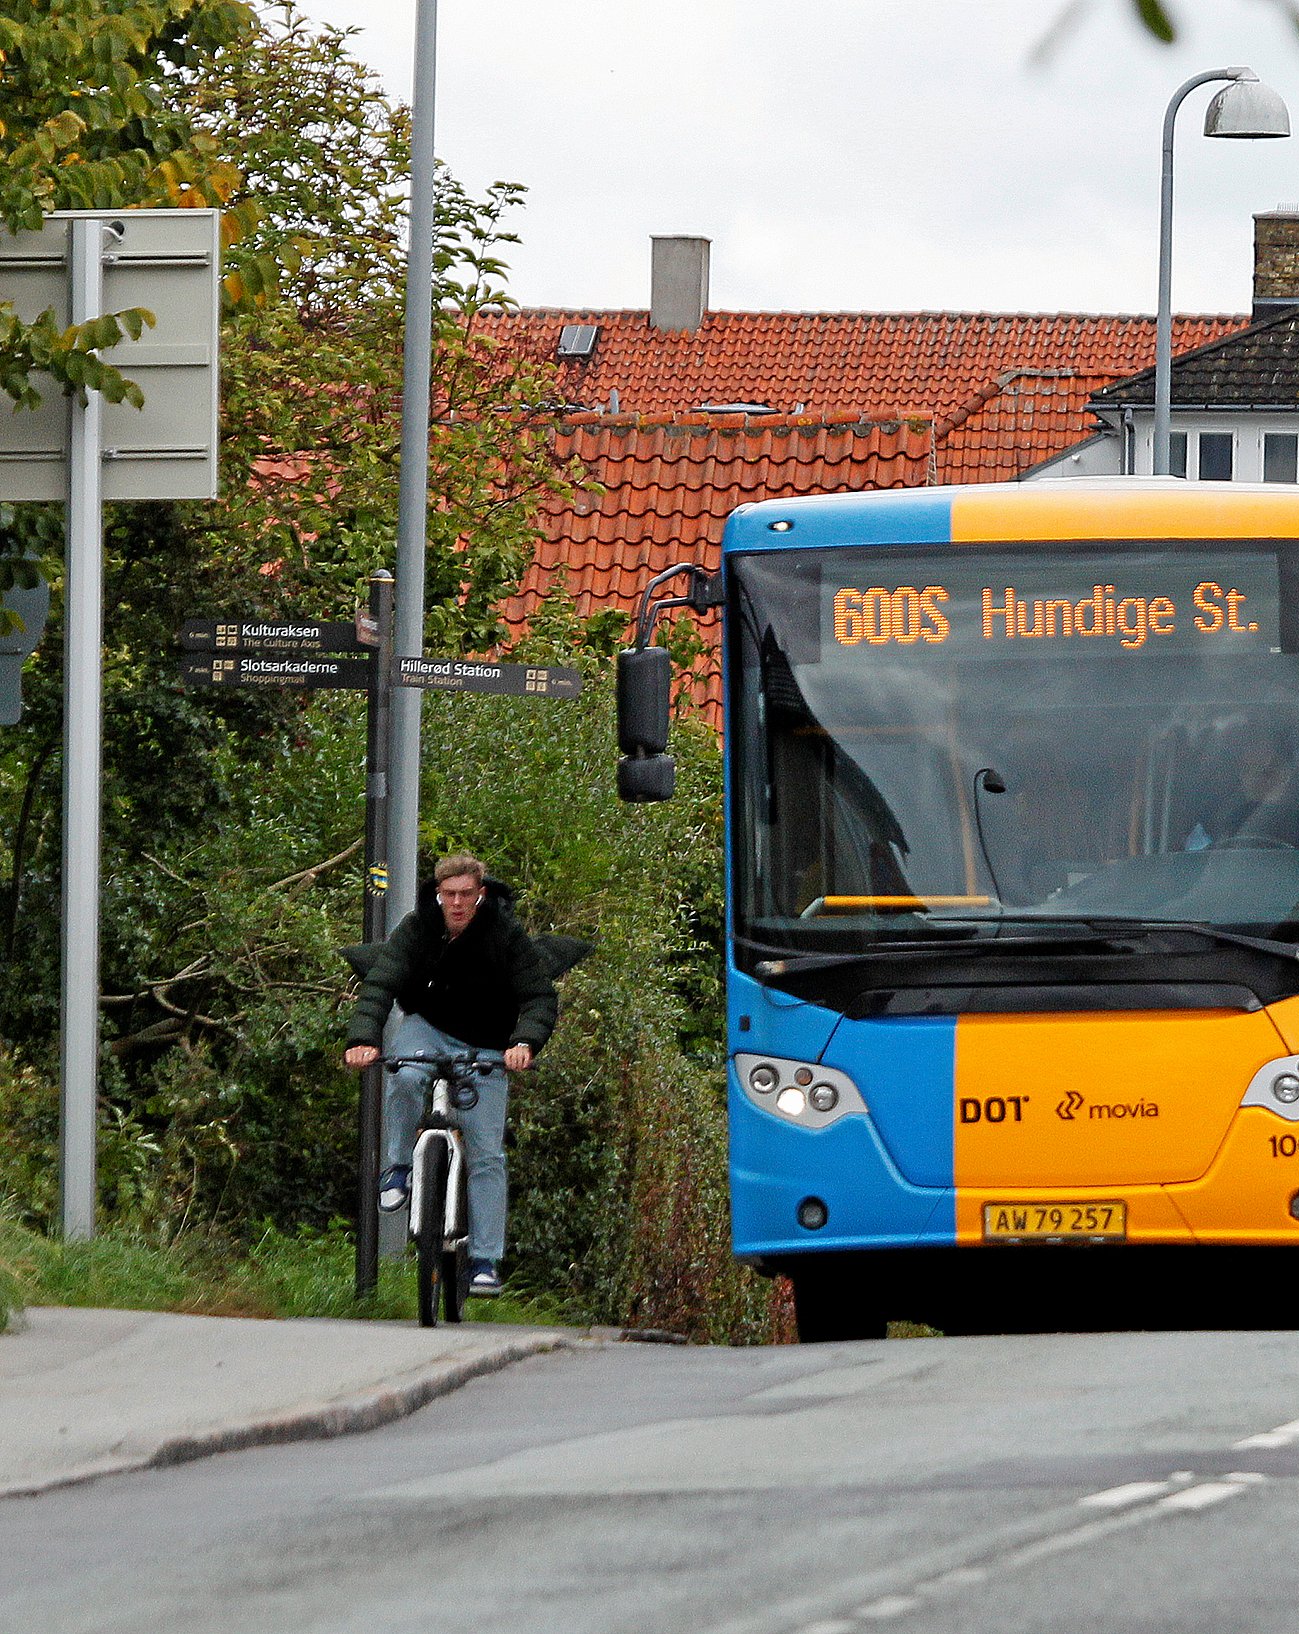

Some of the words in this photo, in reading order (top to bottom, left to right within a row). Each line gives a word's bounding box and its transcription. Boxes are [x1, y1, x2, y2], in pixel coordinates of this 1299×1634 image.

[832, 585, 950, 645] 600S
[981, 583, 1176, 649] Hundige
[1193, 581, 1259, 633] St.
[241, 624, 319, 638] Kulturaksen
[243, 638, 261, 647] The
[263, 638, 298, 648] Culture
[300, 639, 321, 649] Axis
[241, 659, 338, 674] Slotsarkaderne
[400, 659, 450, 675] Hillerød
[454, 663, 501, 678] Station
[401, 673, 425, 684] Train
[427, 676, 463, 687] Station
[959, 1096, 1023, 1123] DOT
[1089, 1099, 1159, 1120] movia
[996, 1213, 1028, 1232] AW
[1035, 1210, 1062, 1230] 79
[1071, 1208, 1113, 1231] 257
